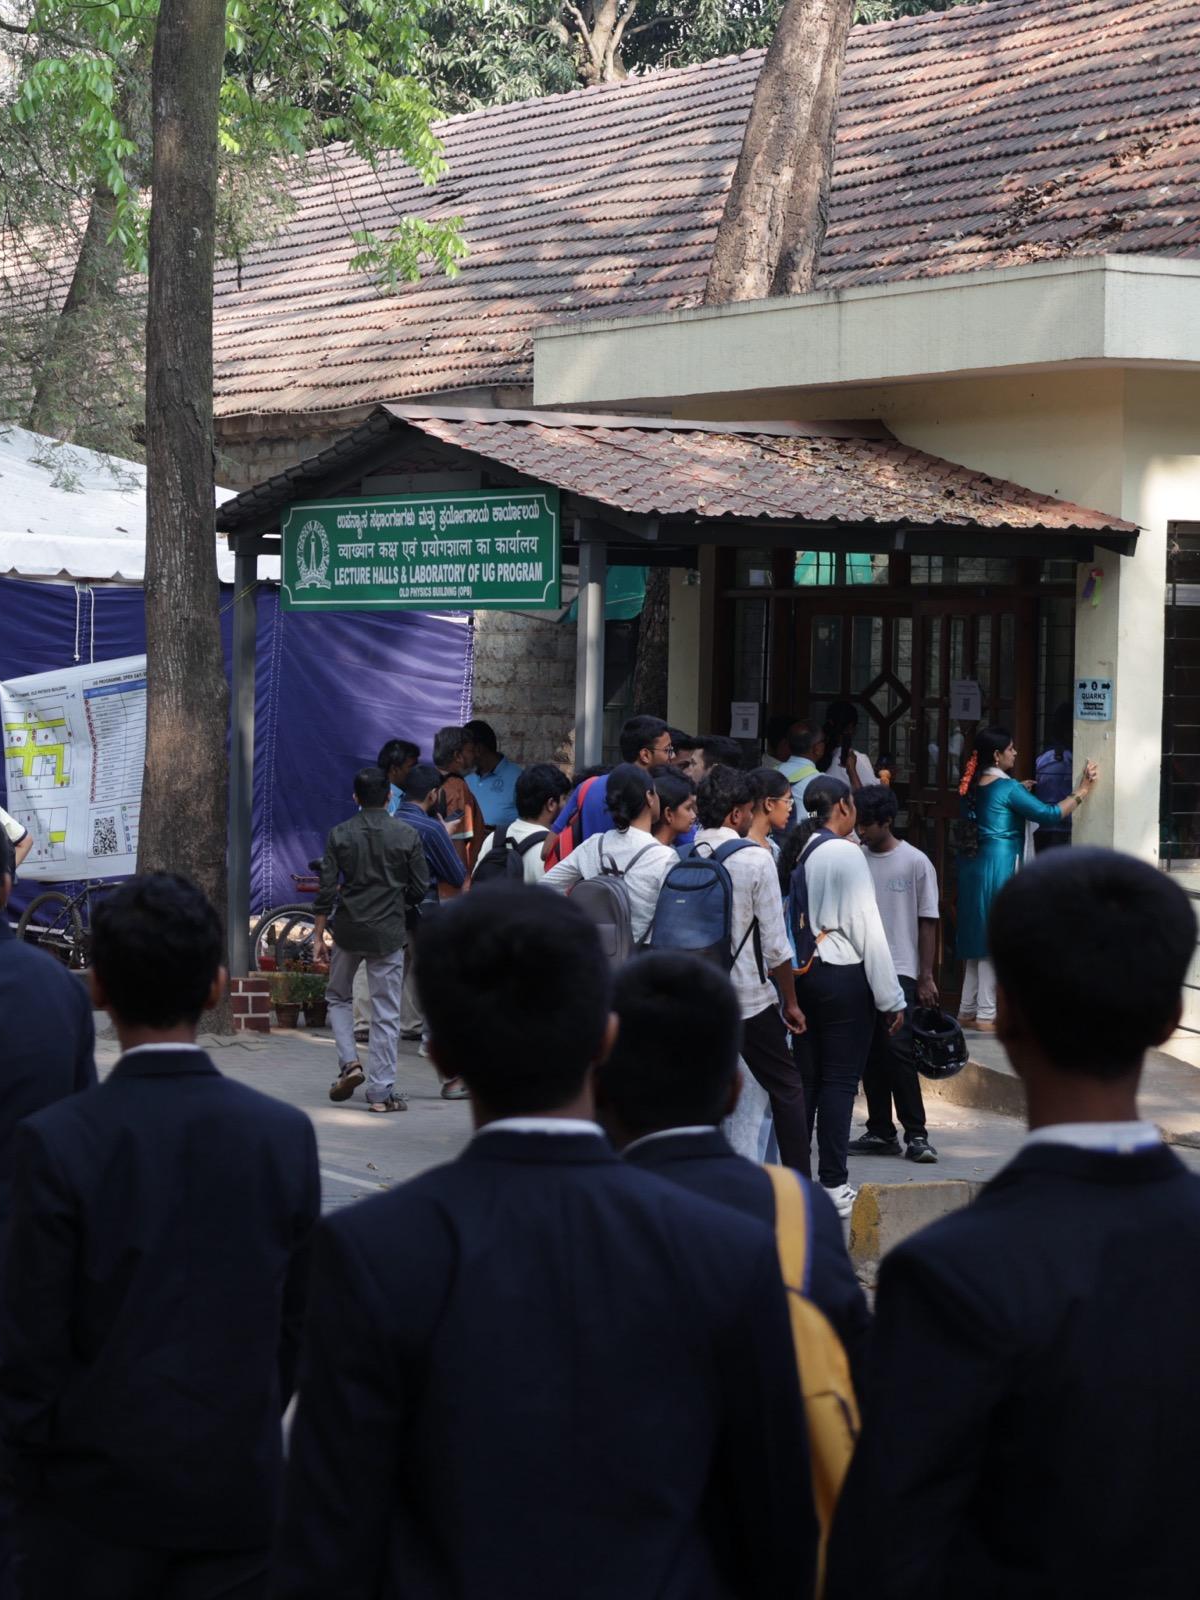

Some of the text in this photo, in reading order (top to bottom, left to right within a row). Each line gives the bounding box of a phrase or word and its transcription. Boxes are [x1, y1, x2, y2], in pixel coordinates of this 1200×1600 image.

[337, 530, 539, 561] व्याख्यान कक्ष एवं प्रयोगशाला का कार्यालय
[334, 561, 543, 585] LECTURE HALLS & LABORATORY OF UG PROGRAM
[399, 587, 410, 598] OLD
[410, 586, 432, 597] PHYSICS
[432, 586, 457, 597] BUILDING
[1081, 692, 1106, 700] QUARKS
